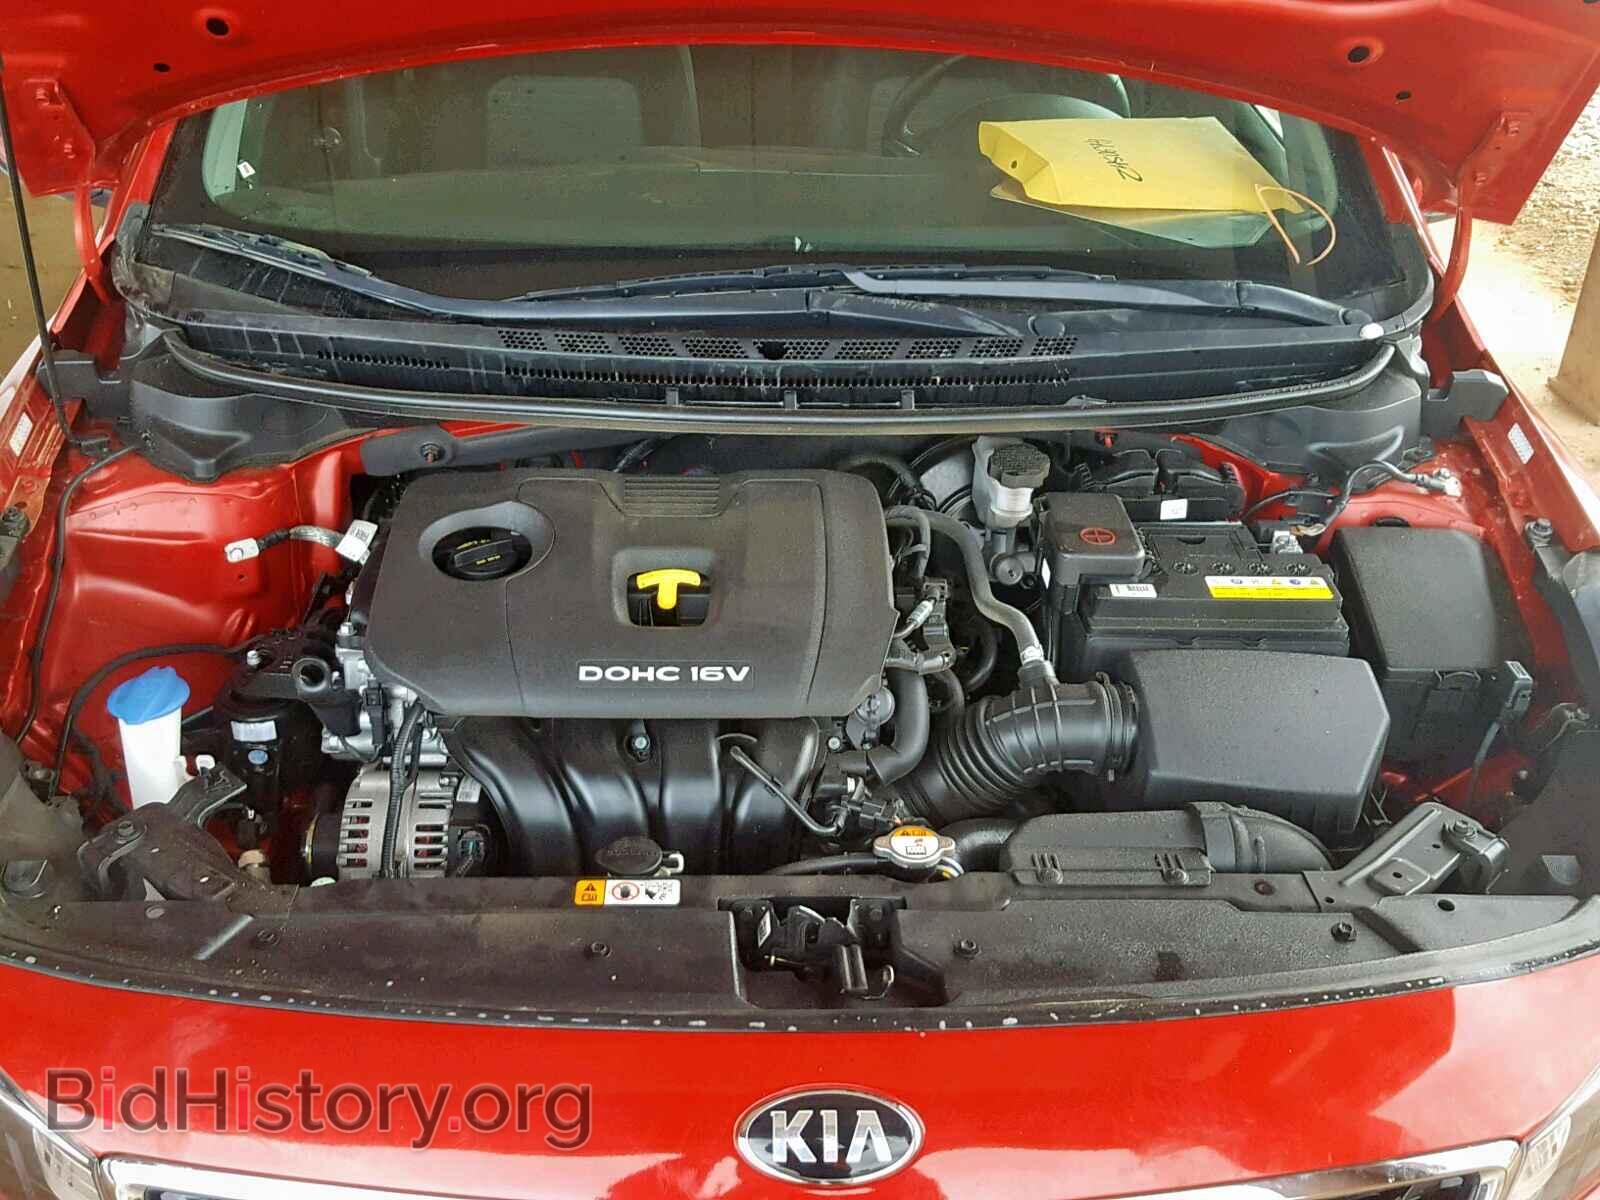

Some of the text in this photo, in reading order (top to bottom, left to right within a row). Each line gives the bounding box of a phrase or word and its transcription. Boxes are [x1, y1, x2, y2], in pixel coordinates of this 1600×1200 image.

[578, 665, 751, 682] DOHC 16V
[769, 1109, 893, 1163] KIA
